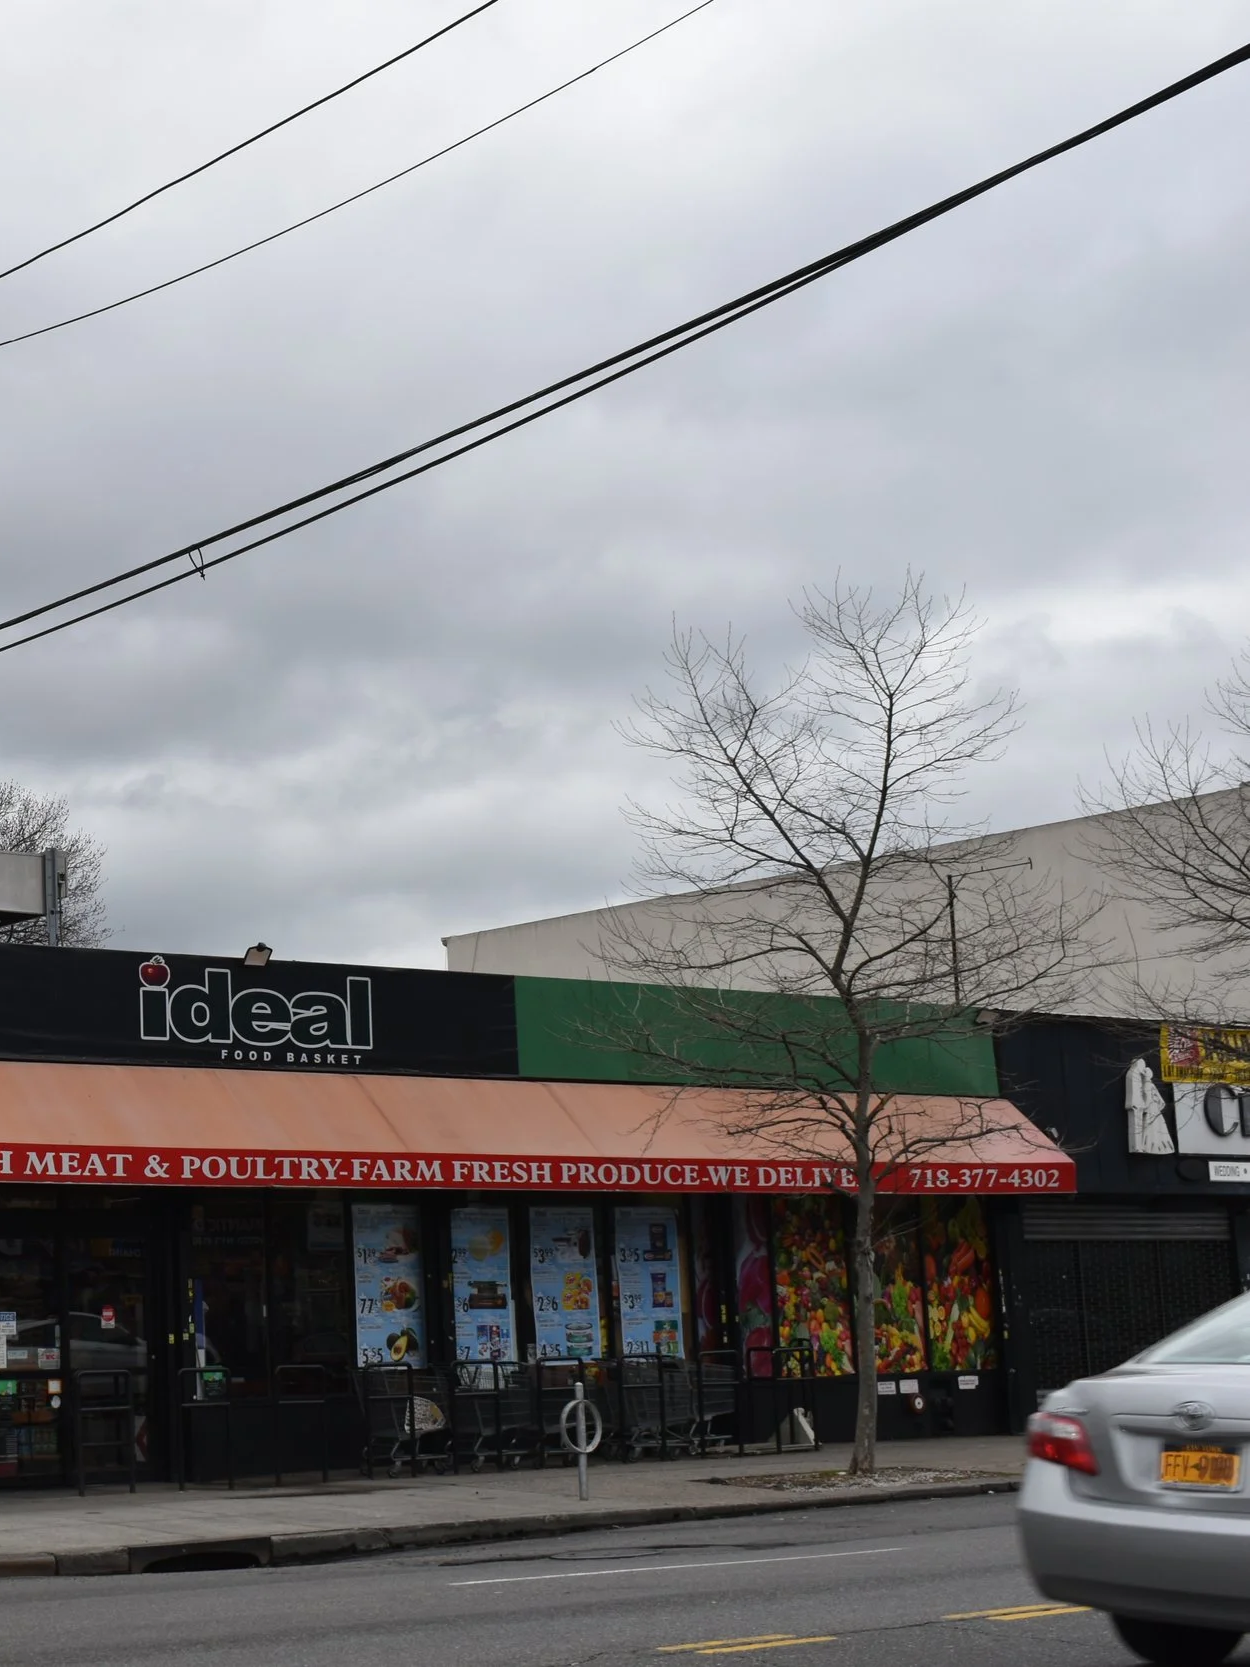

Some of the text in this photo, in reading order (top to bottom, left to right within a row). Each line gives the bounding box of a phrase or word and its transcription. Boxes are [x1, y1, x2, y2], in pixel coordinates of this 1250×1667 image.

[139, 955, 373, 1049] ideal
[221, 1050, 362, 1065] FOOD BASKET
[23, 1151, 133, 1178] MEAT
[144, 1154, 170, 1178] &
[180, 1156, 444, 1182] POULTRY-FARM
[452, 1160, 554, 1184] FRESH
[560, 1164, 750, 1188] PRODUCE-WE
[757, 1166, 858, 1188] DELIVE
[910, 1168, 1060, 1188] 718-377-4302
